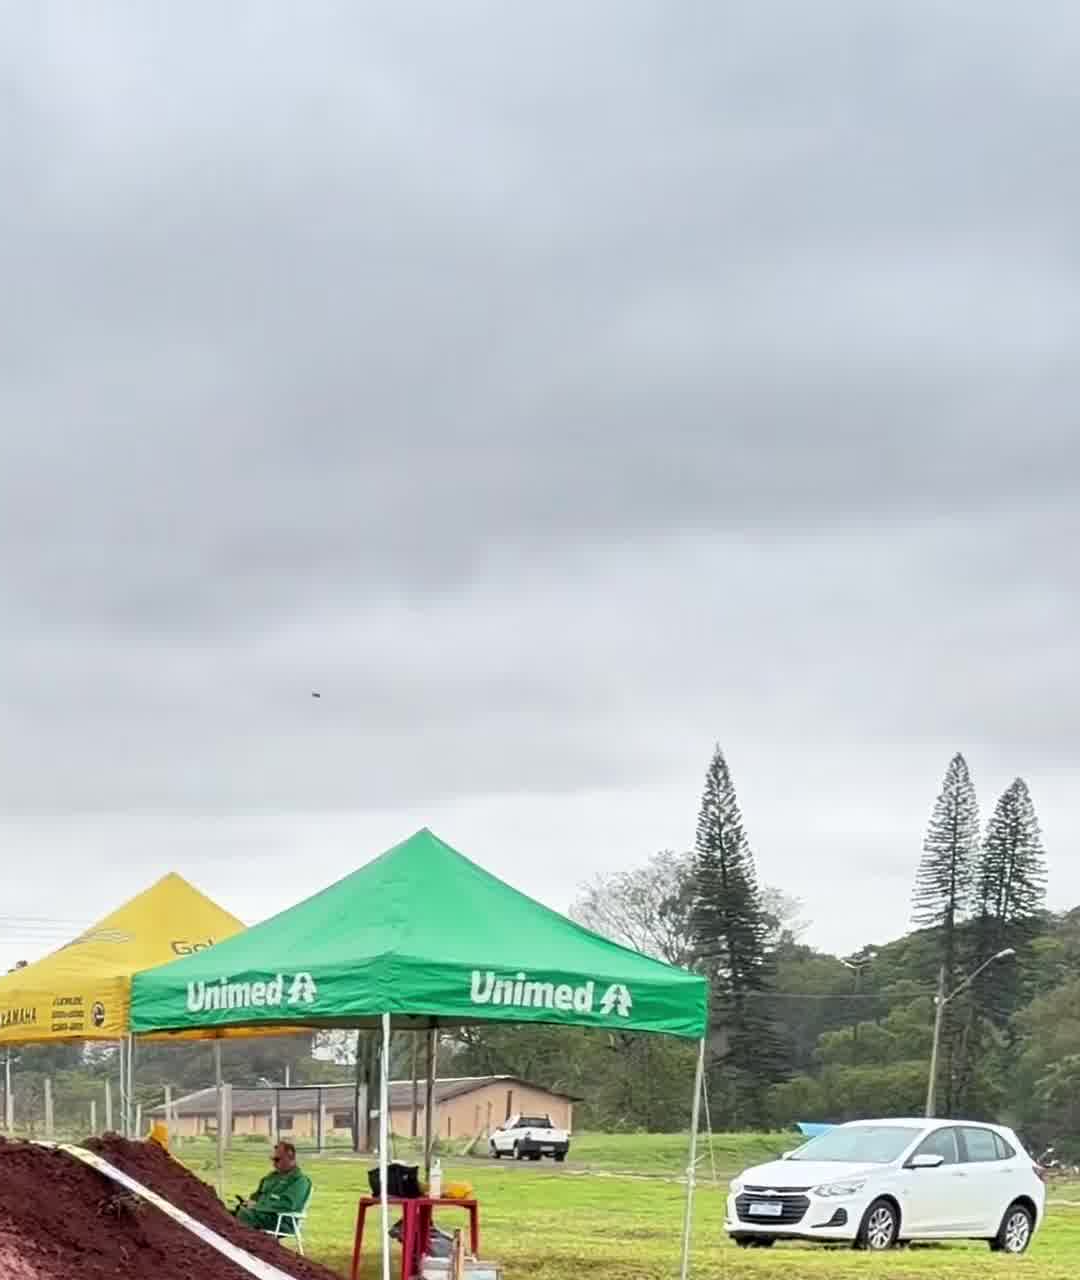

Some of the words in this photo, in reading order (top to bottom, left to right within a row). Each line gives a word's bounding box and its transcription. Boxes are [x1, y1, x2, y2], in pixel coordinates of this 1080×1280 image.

[186, 972, 284, 1012] Unimed
[470, 970, 595, 1013] Unimed
[0, 1007, 37, 1027] YAMAHA
